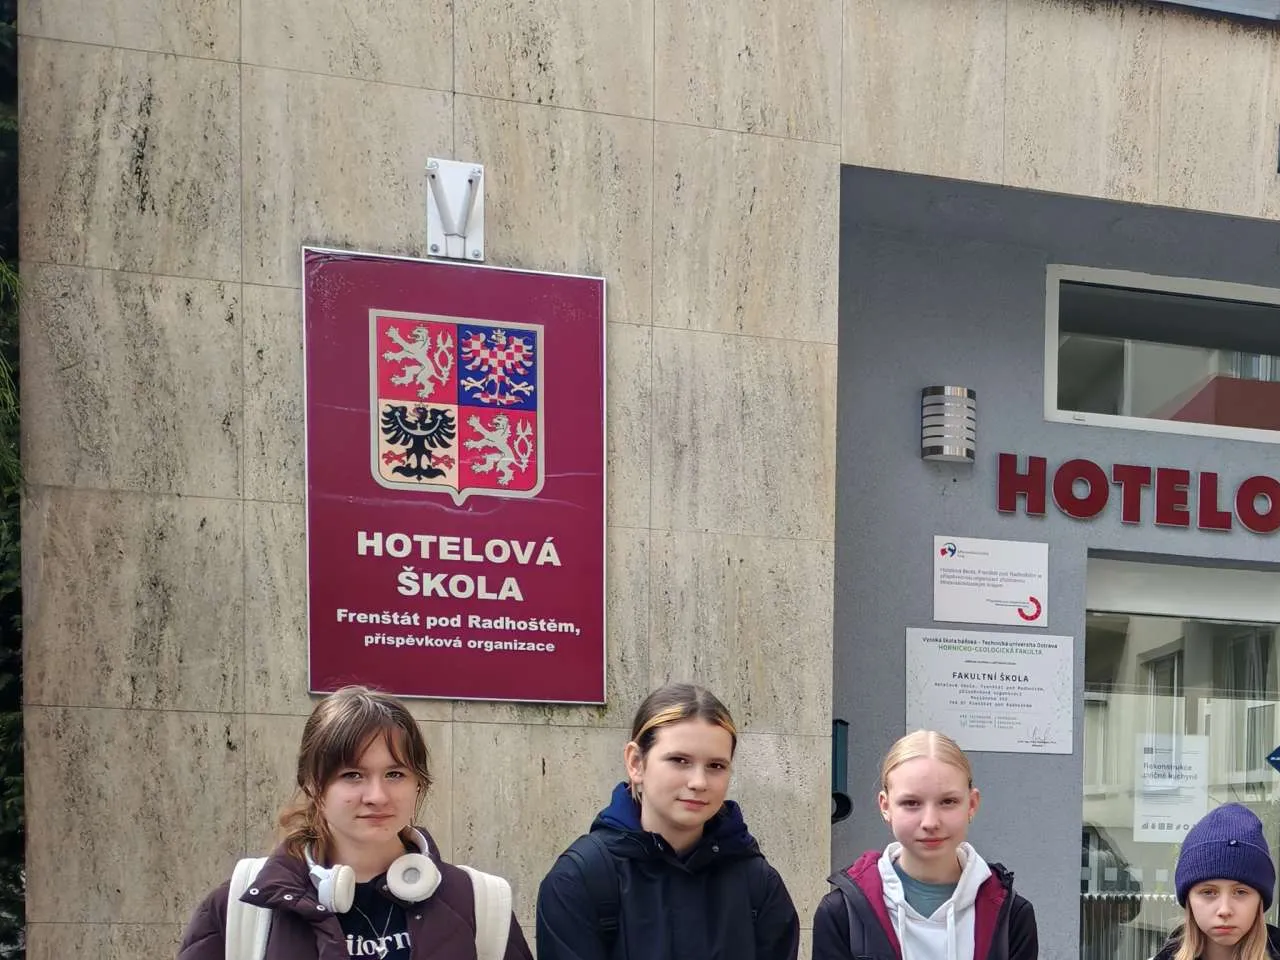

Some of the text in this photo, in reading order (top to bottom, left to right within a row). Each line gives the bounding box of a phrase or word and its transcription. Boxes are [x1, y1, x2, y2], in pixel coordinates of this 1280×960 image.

[357, 531, 562, 567] HOTELOVÁ
[397, 565, 524, 601] ŠKOLA
[337, 608, 581, 635] Frenštát pod Radhoštěm,
[364, 633, 556, 652] příspěvková organizace
[952, 671, 1029, 682] FAKULTNÍ ŠKOLA
